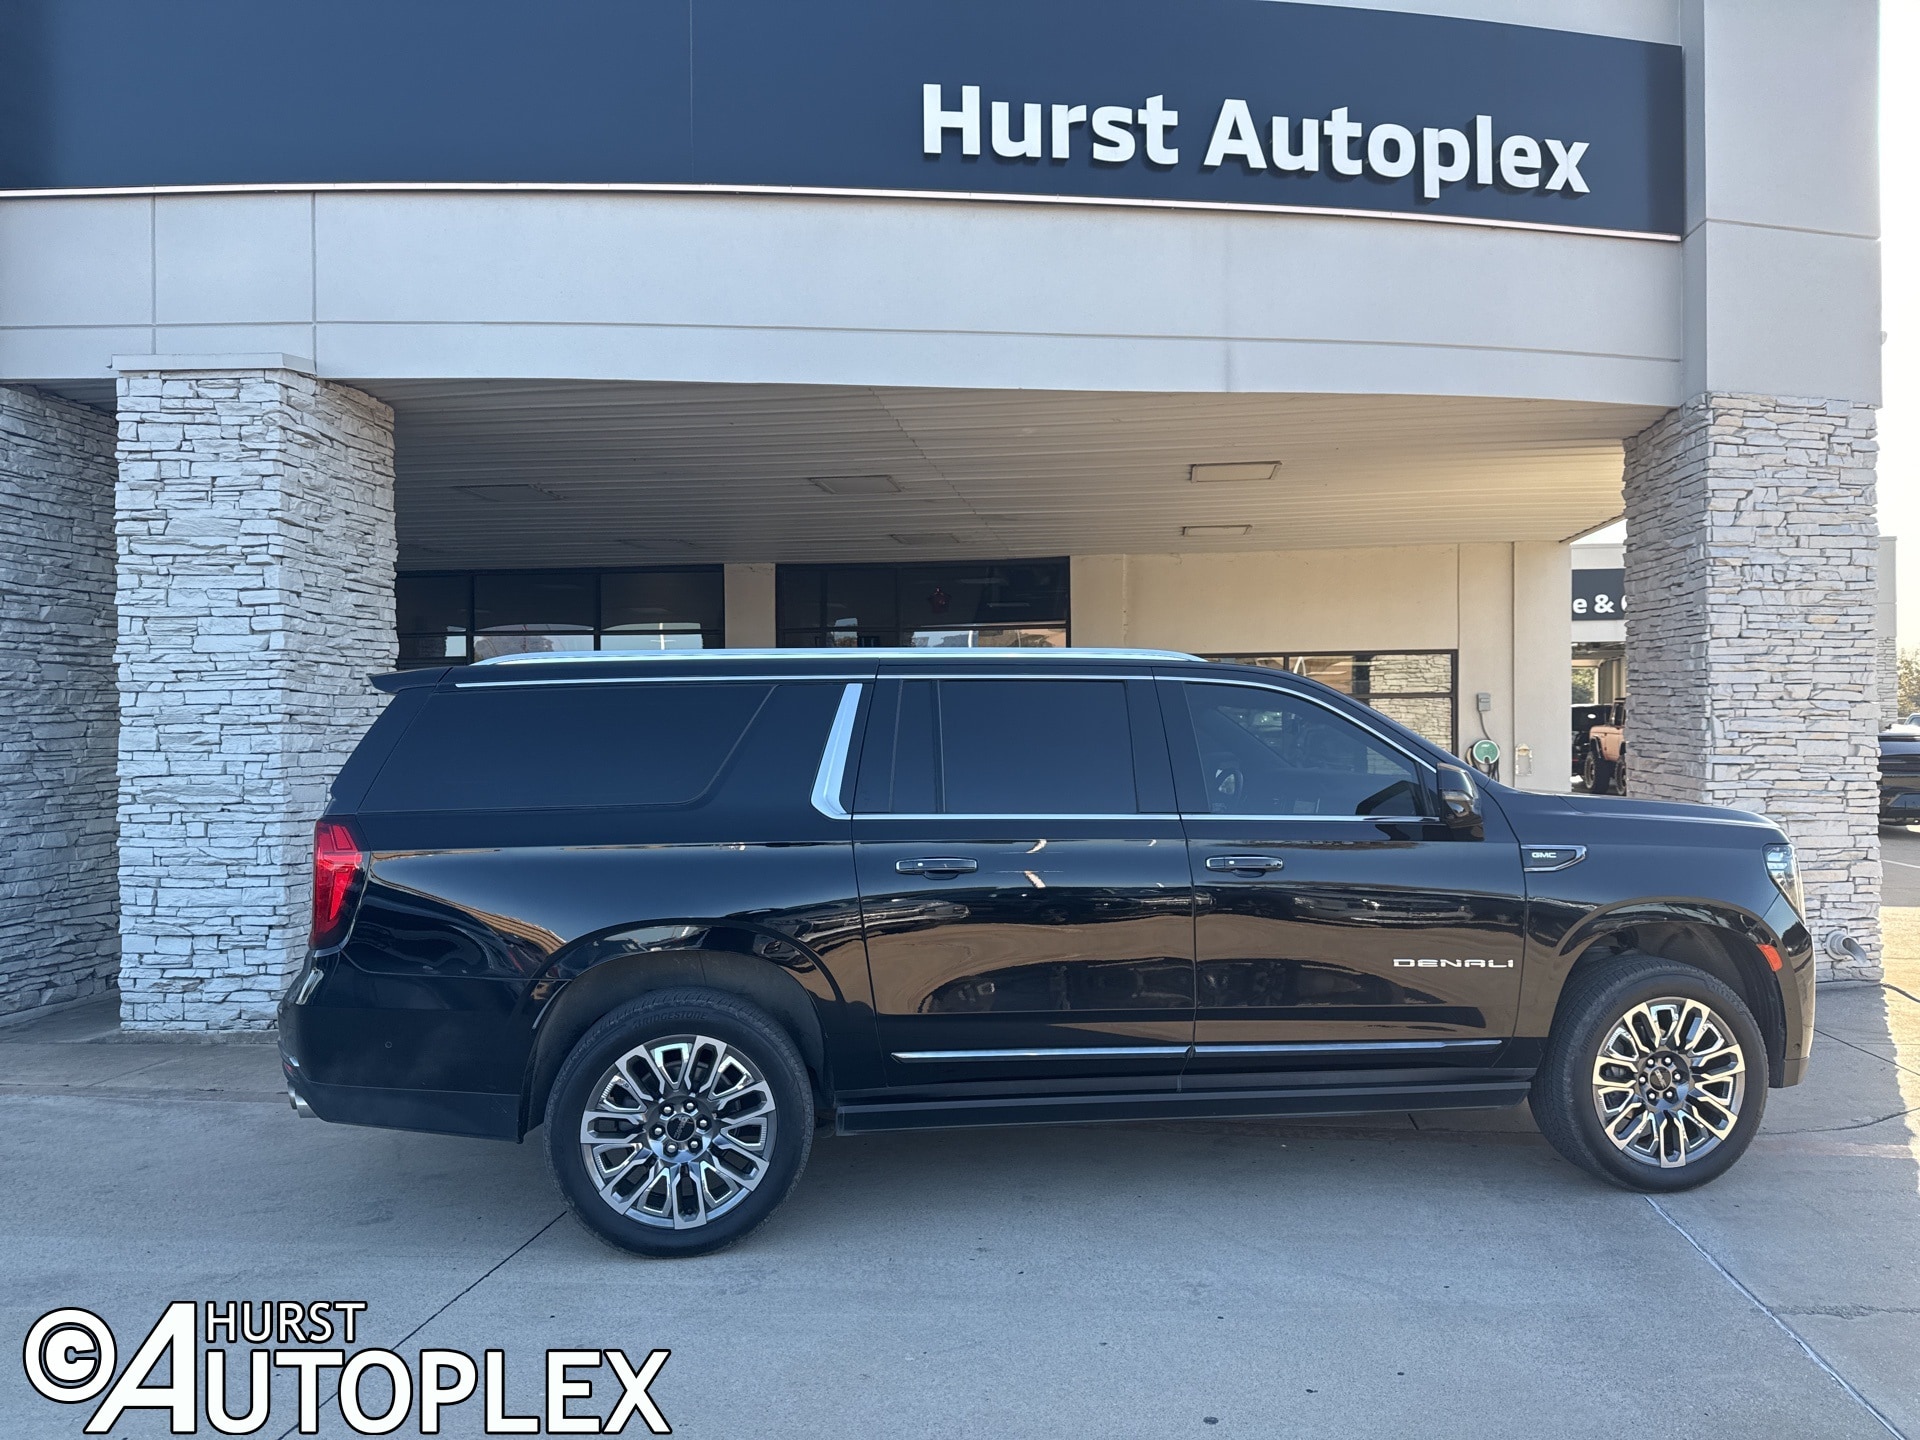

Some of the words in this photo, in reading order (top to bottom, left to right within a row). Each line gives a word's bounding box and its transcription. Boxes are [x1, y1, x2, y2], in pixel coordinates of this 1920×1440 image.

[922, 83, 1180, 166] Hurst
[1203, 98, 1591, 199] Autoplex
[1593, 593, 1615, 614] &
[1531, 851, 1557, 859] GMC
[1393, 958, 1514, 968] DENALI
[631, 1010, 708, 1030] BRIDGESTONE
